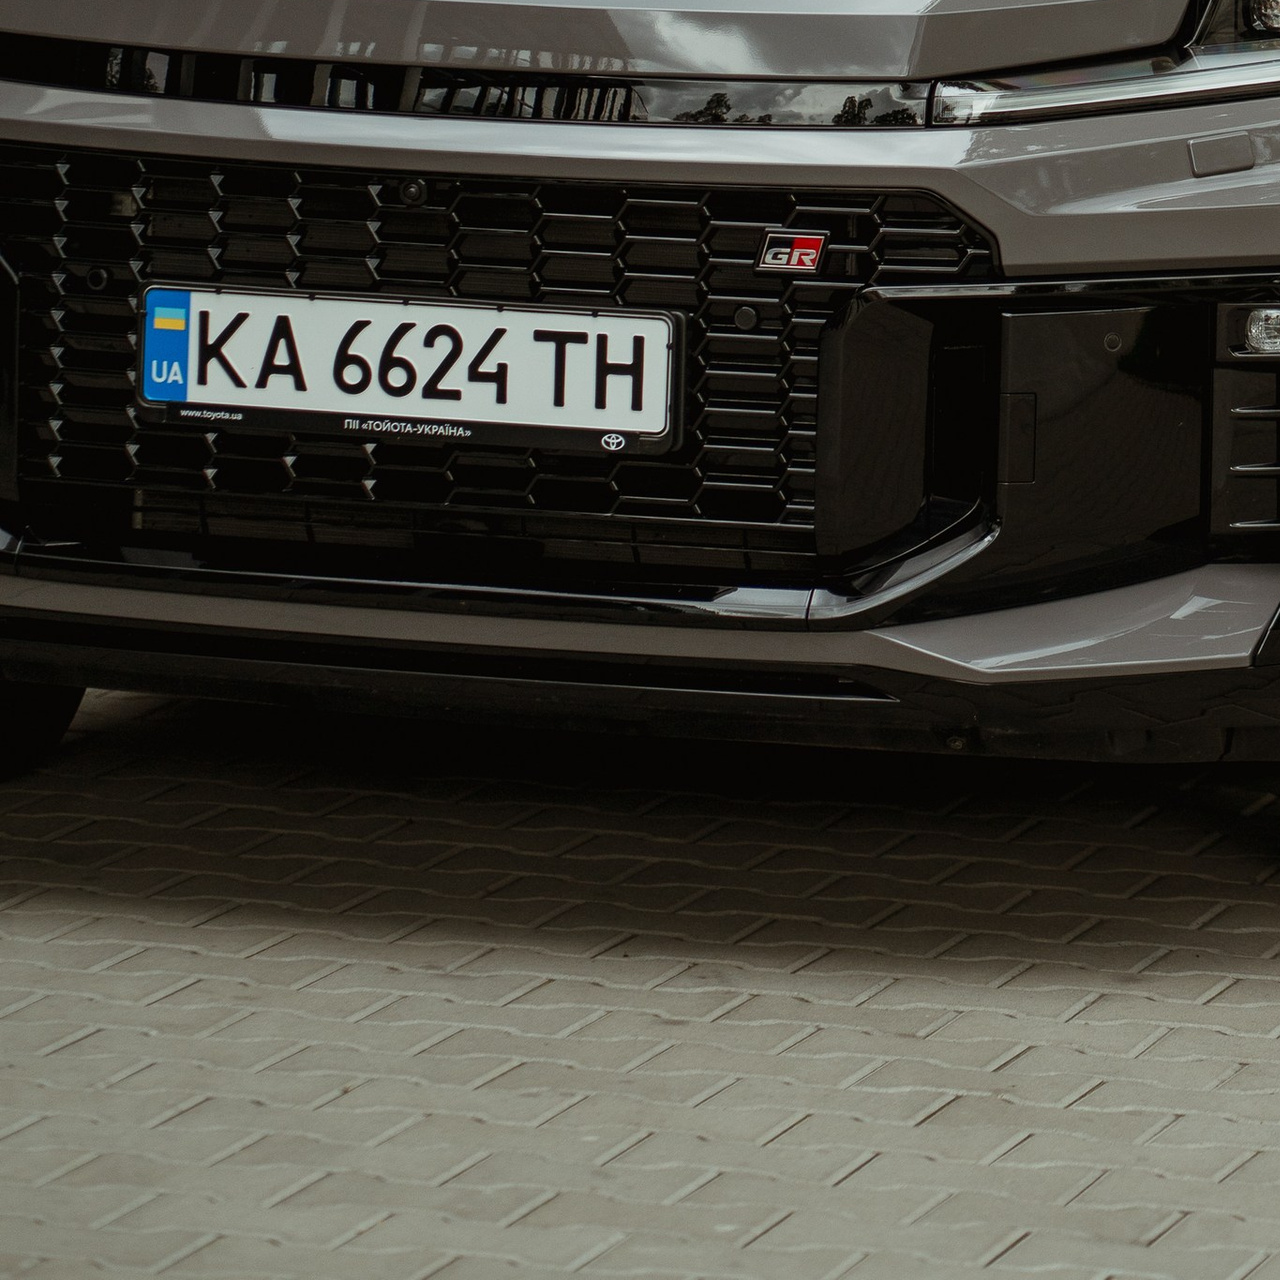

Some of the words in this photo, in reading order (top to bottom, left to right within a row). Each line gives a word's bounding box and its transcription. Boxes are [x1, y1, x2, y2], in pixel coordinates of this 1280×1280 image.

[764, 247, 817, 266] GR
[151, 359, 184, 385] UA
[197, 310, 308, 392] KA
[333, 319, 509, 405] 6624
[533, 328, 645, 412] TH
[179, 409, 243, 421] www.toyota.ua
